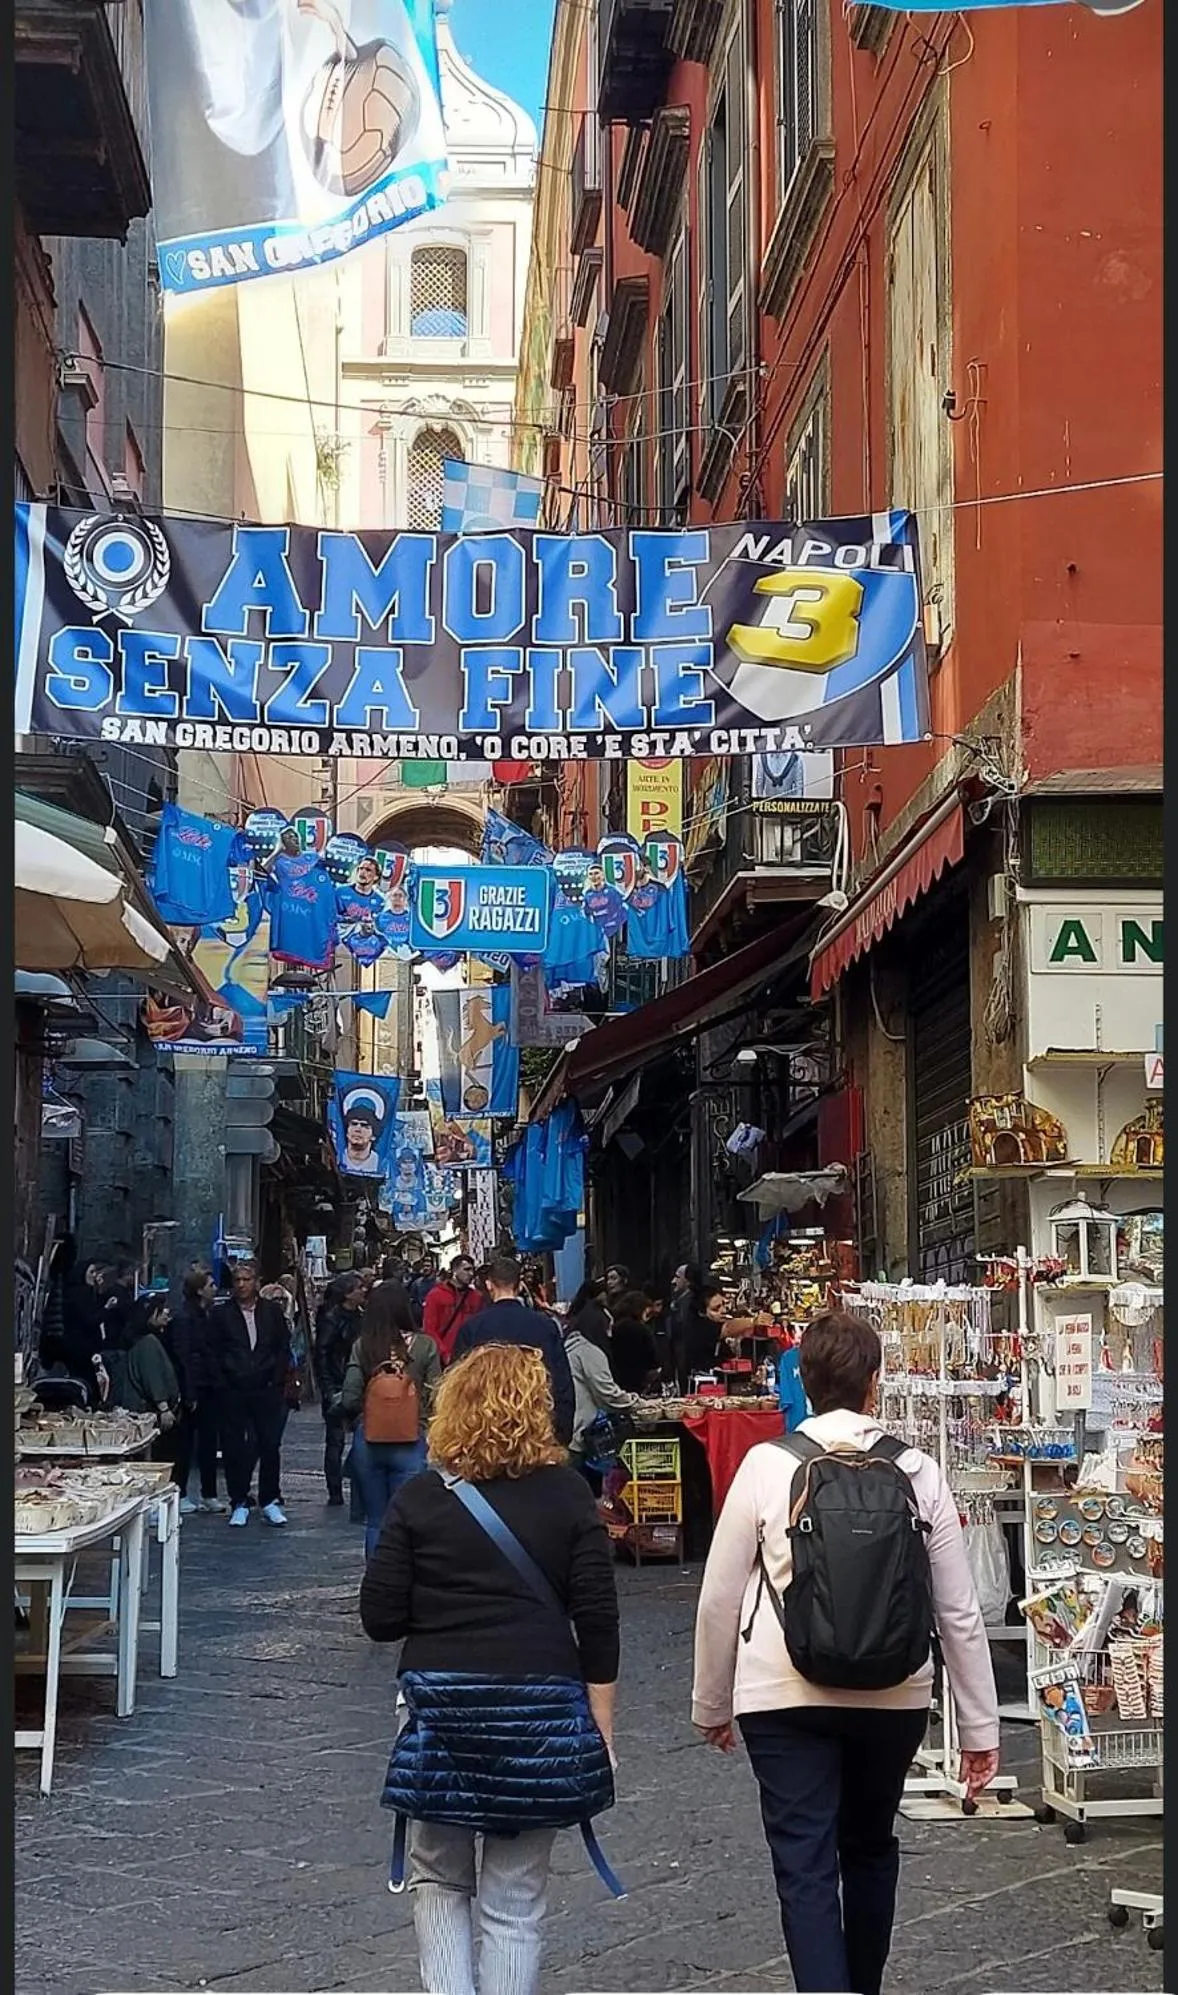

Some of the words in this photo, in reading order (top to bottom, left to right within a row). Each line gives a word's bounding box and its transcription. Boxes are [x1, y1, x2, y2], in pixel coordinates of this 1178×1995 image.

[186, 241, 261, 281] SAN
[730, 531, 915, 573] NAPOLI
[201, 526, 713, 644] AMORE
[724, 570, 866, 674] 3
[45, 625, 420, 731] SENZA
[458, 642, 716, 734] FINE
[100, 717, 168, 745] SAN
[174, 722, 320, 755] GREGORIO
[327, 731, 468, 762] ARMENO,
[508, 733, 588, 760] CORE
[752, 801, 830, 814] PERSONALIZZATE
[434, 889, 450, 922] 3
[478, 884, 526, 906] GRAZIE
[468, 904, 541, 933] RAGAZZI
